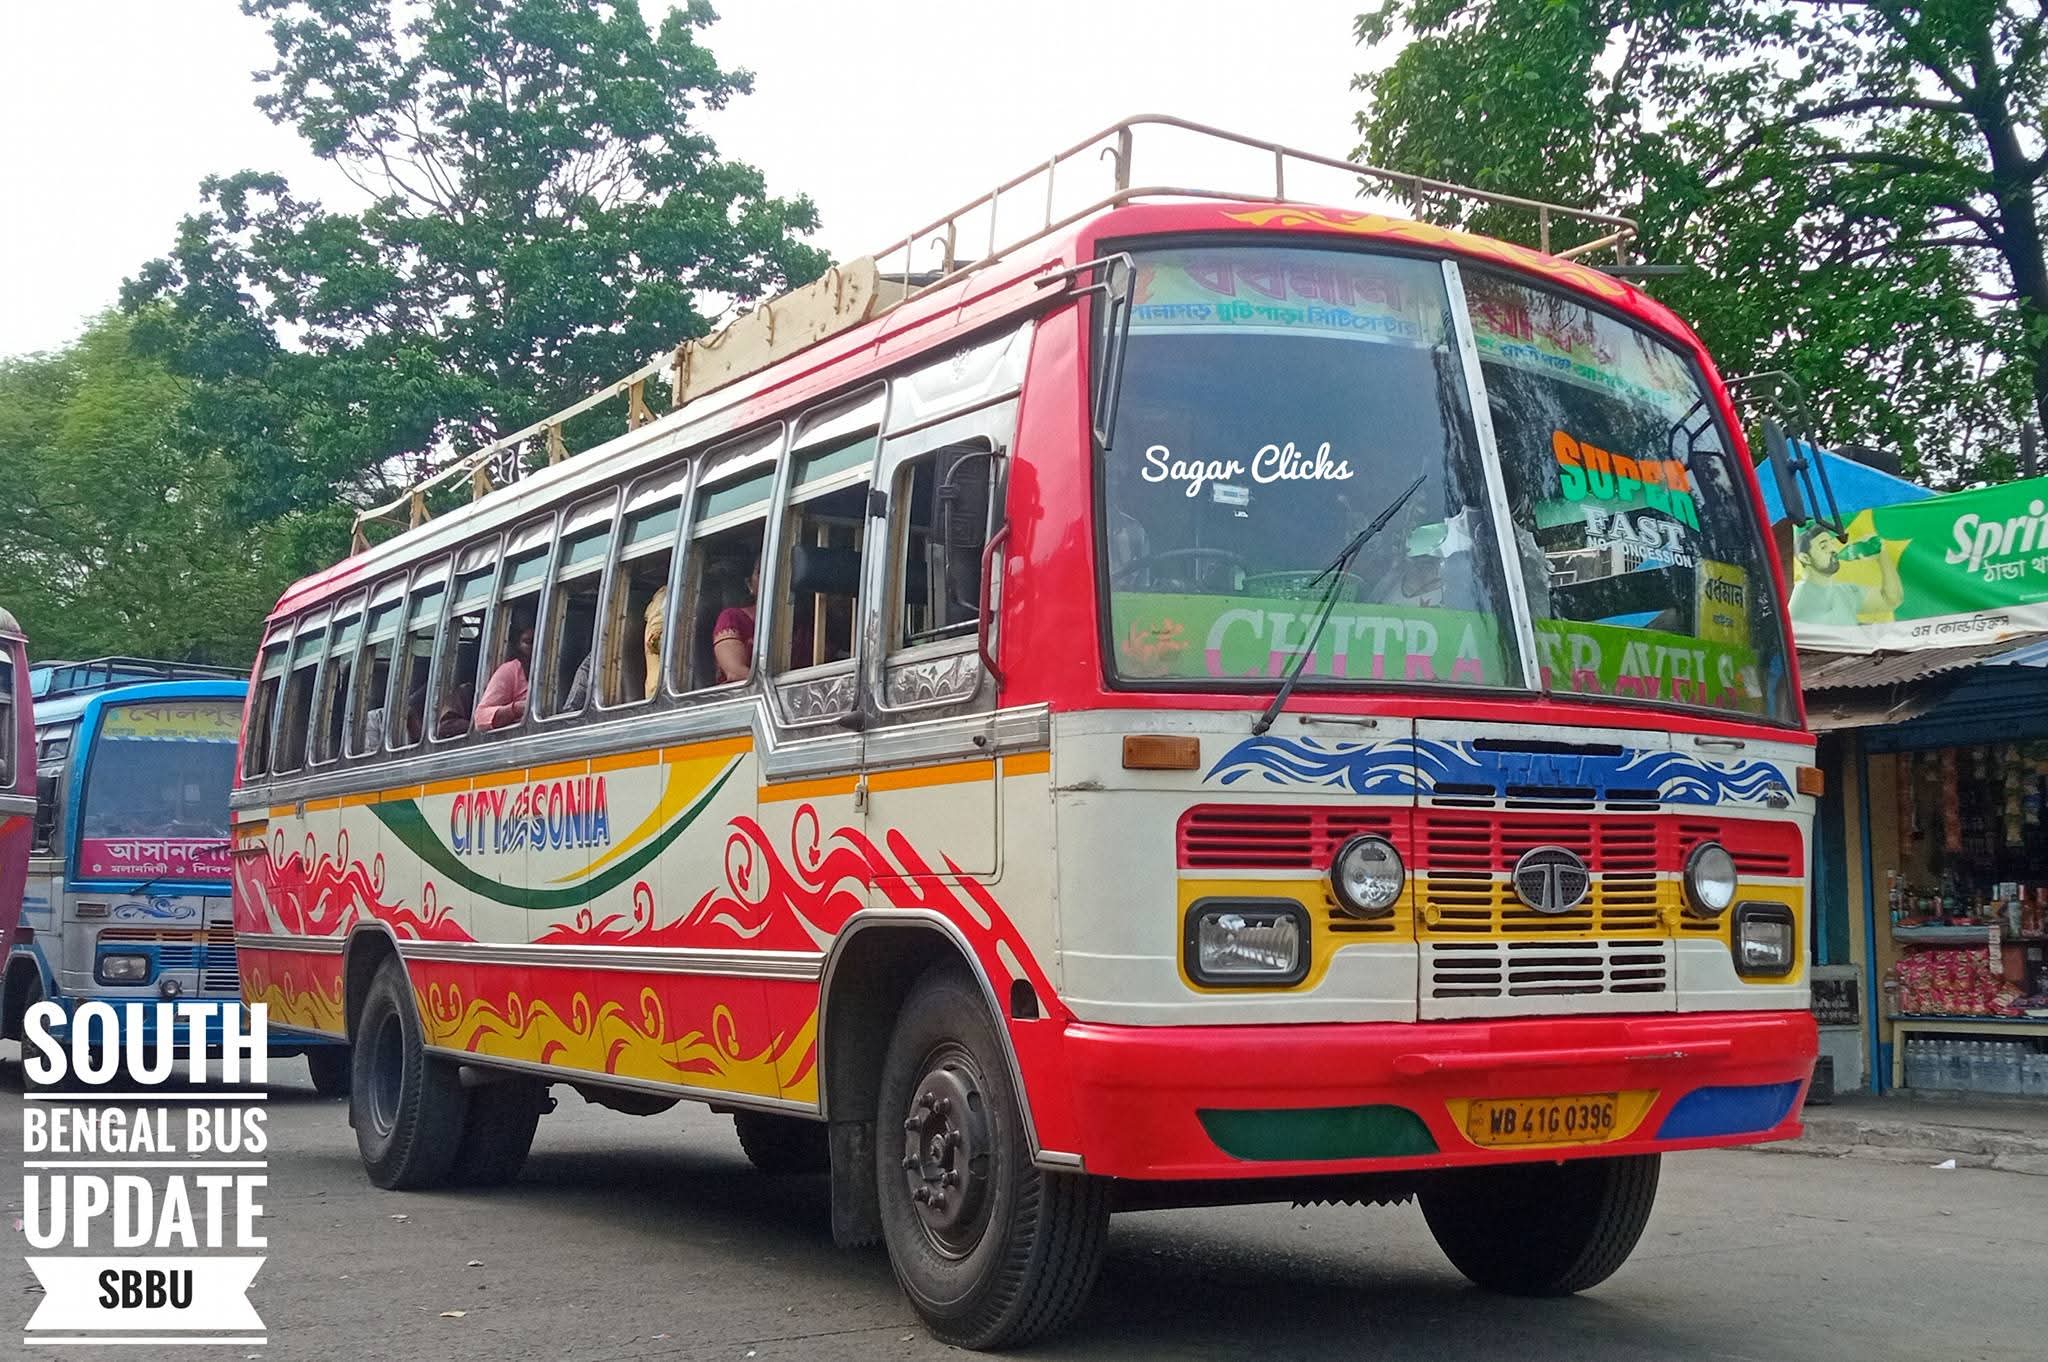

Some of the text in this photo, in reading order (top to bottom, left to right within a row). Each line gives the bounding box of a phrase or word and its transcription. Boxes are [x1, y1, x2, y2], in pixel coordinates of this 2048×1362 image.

[1553, 430, 1700, 532] SUPER
[1580, 504, 1686, 553] FAST
[1586, 536, 1693, 568] NO ONCESSION
[1203, 609, 1738, 706] CHITRA TRAVELS
[450, 789, 507, 856] CITY
[530, 776, 611, 852] SONIA
[1490, 1103, 1613, 1134] WB 41G 0396
